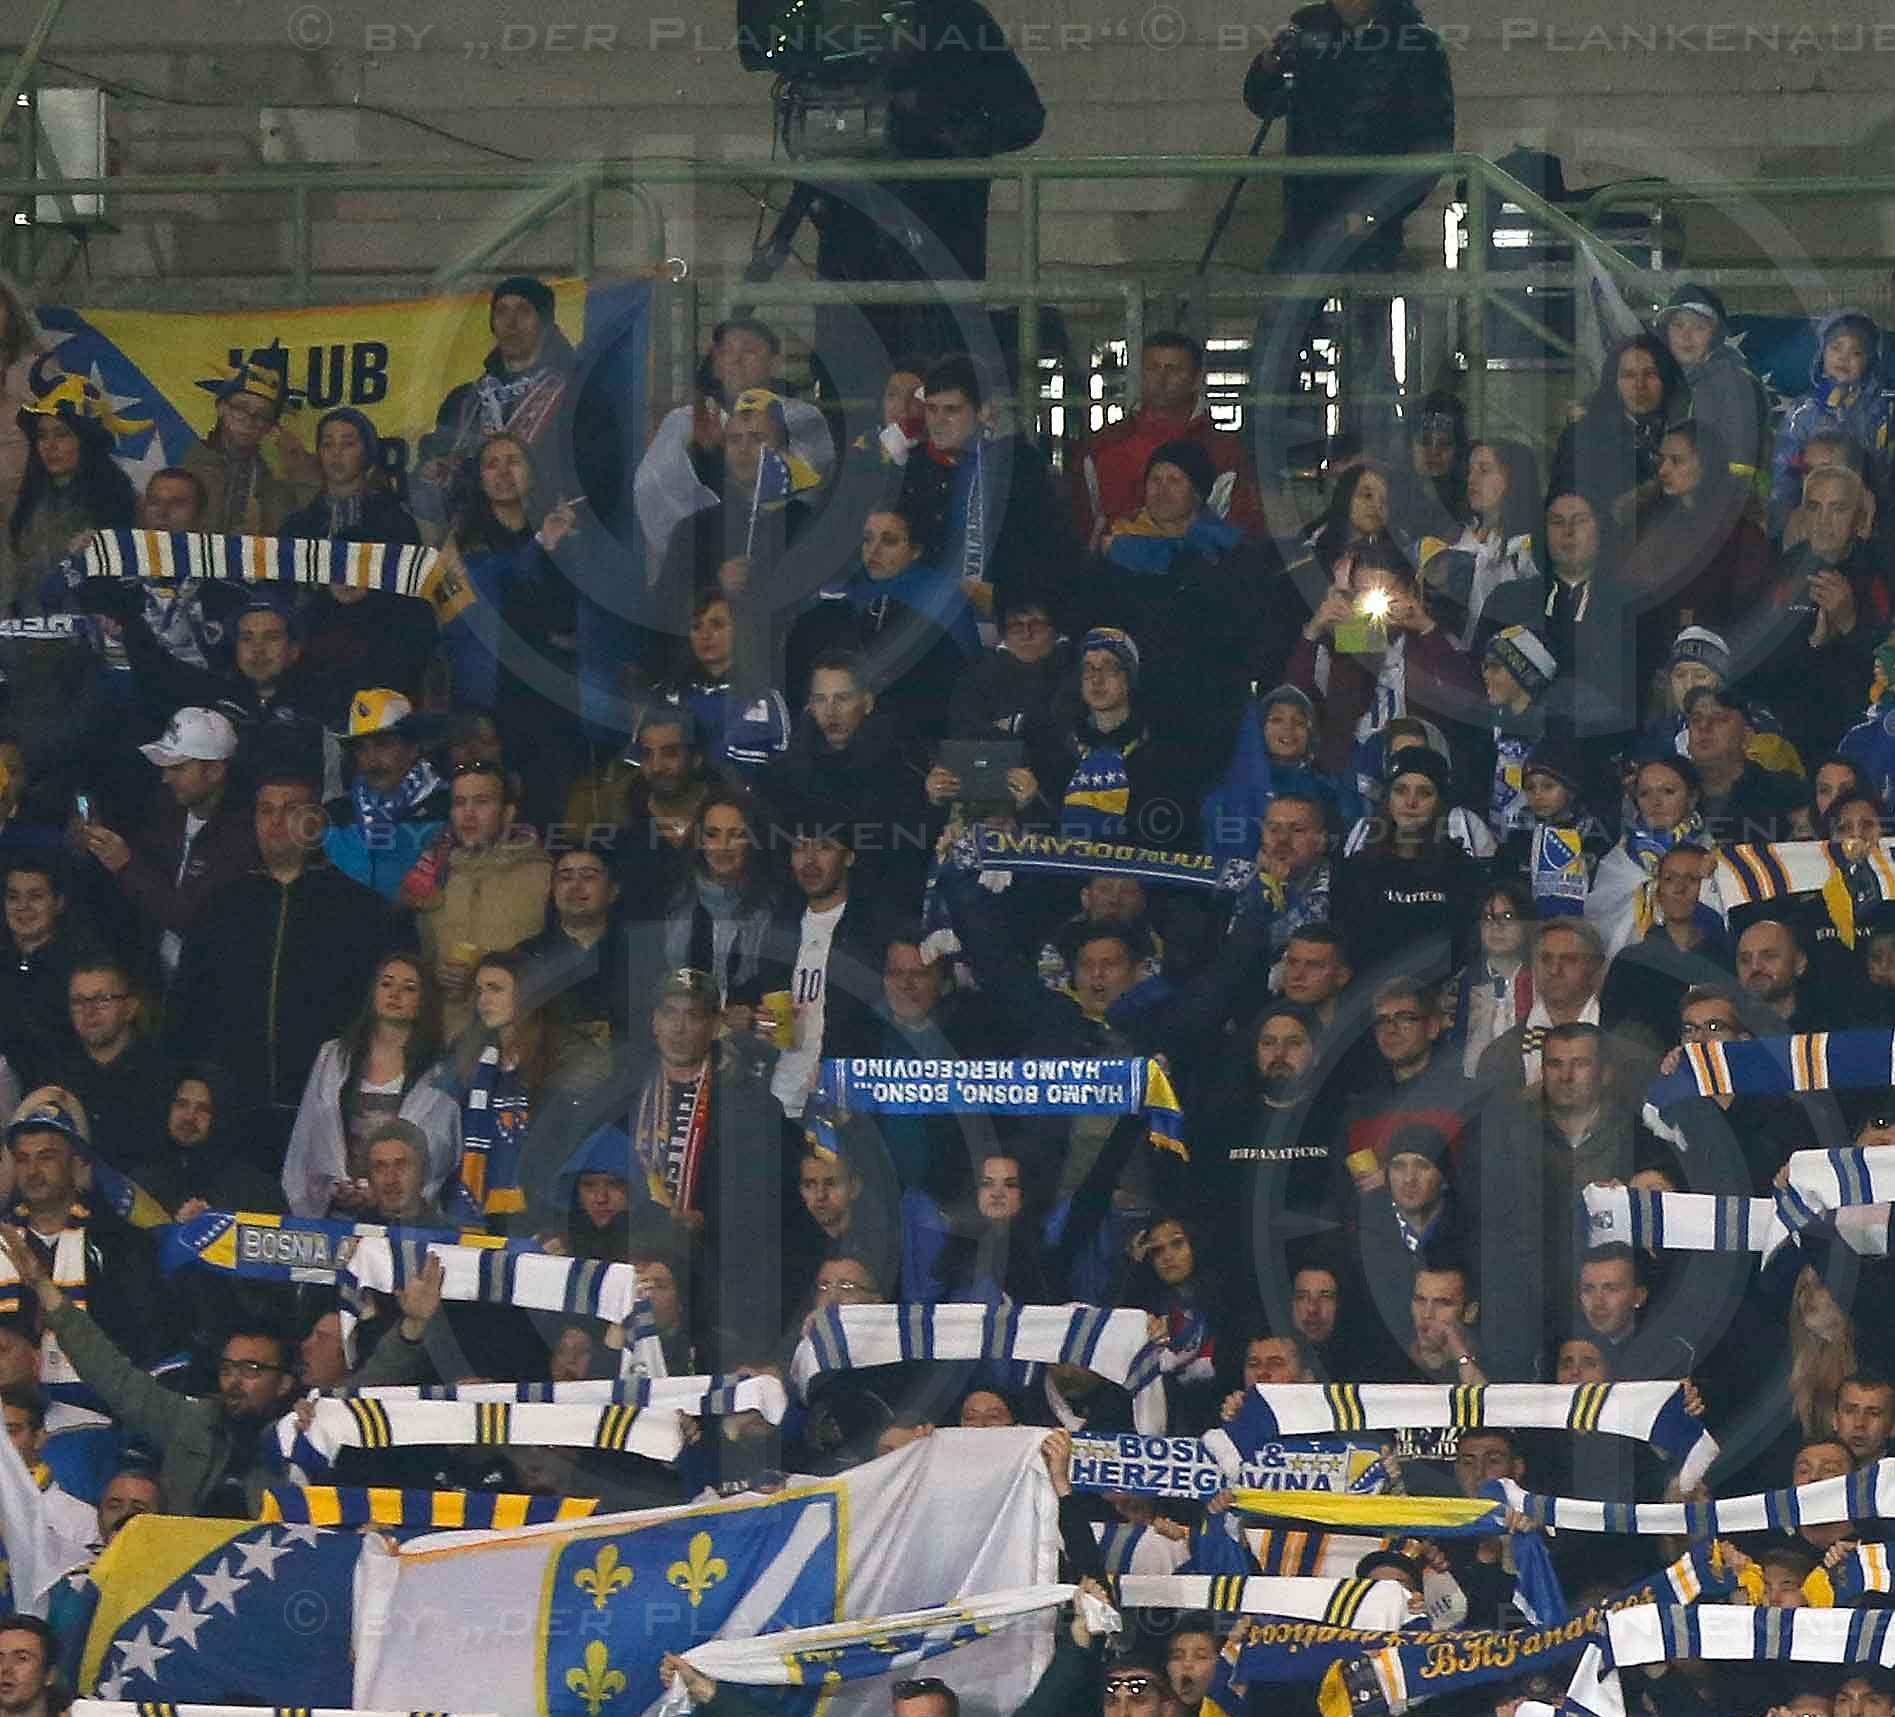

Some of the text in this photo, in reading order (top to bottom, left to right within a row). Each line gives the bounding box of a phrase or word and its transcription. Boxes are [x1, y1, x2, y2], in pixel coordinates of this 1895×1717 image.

[795, 967, 823, 1003] 10
[852, 1058, 1013, 1080] HERCEGOVINO
[1048, 1085, 1124, 1105] HAJMO
